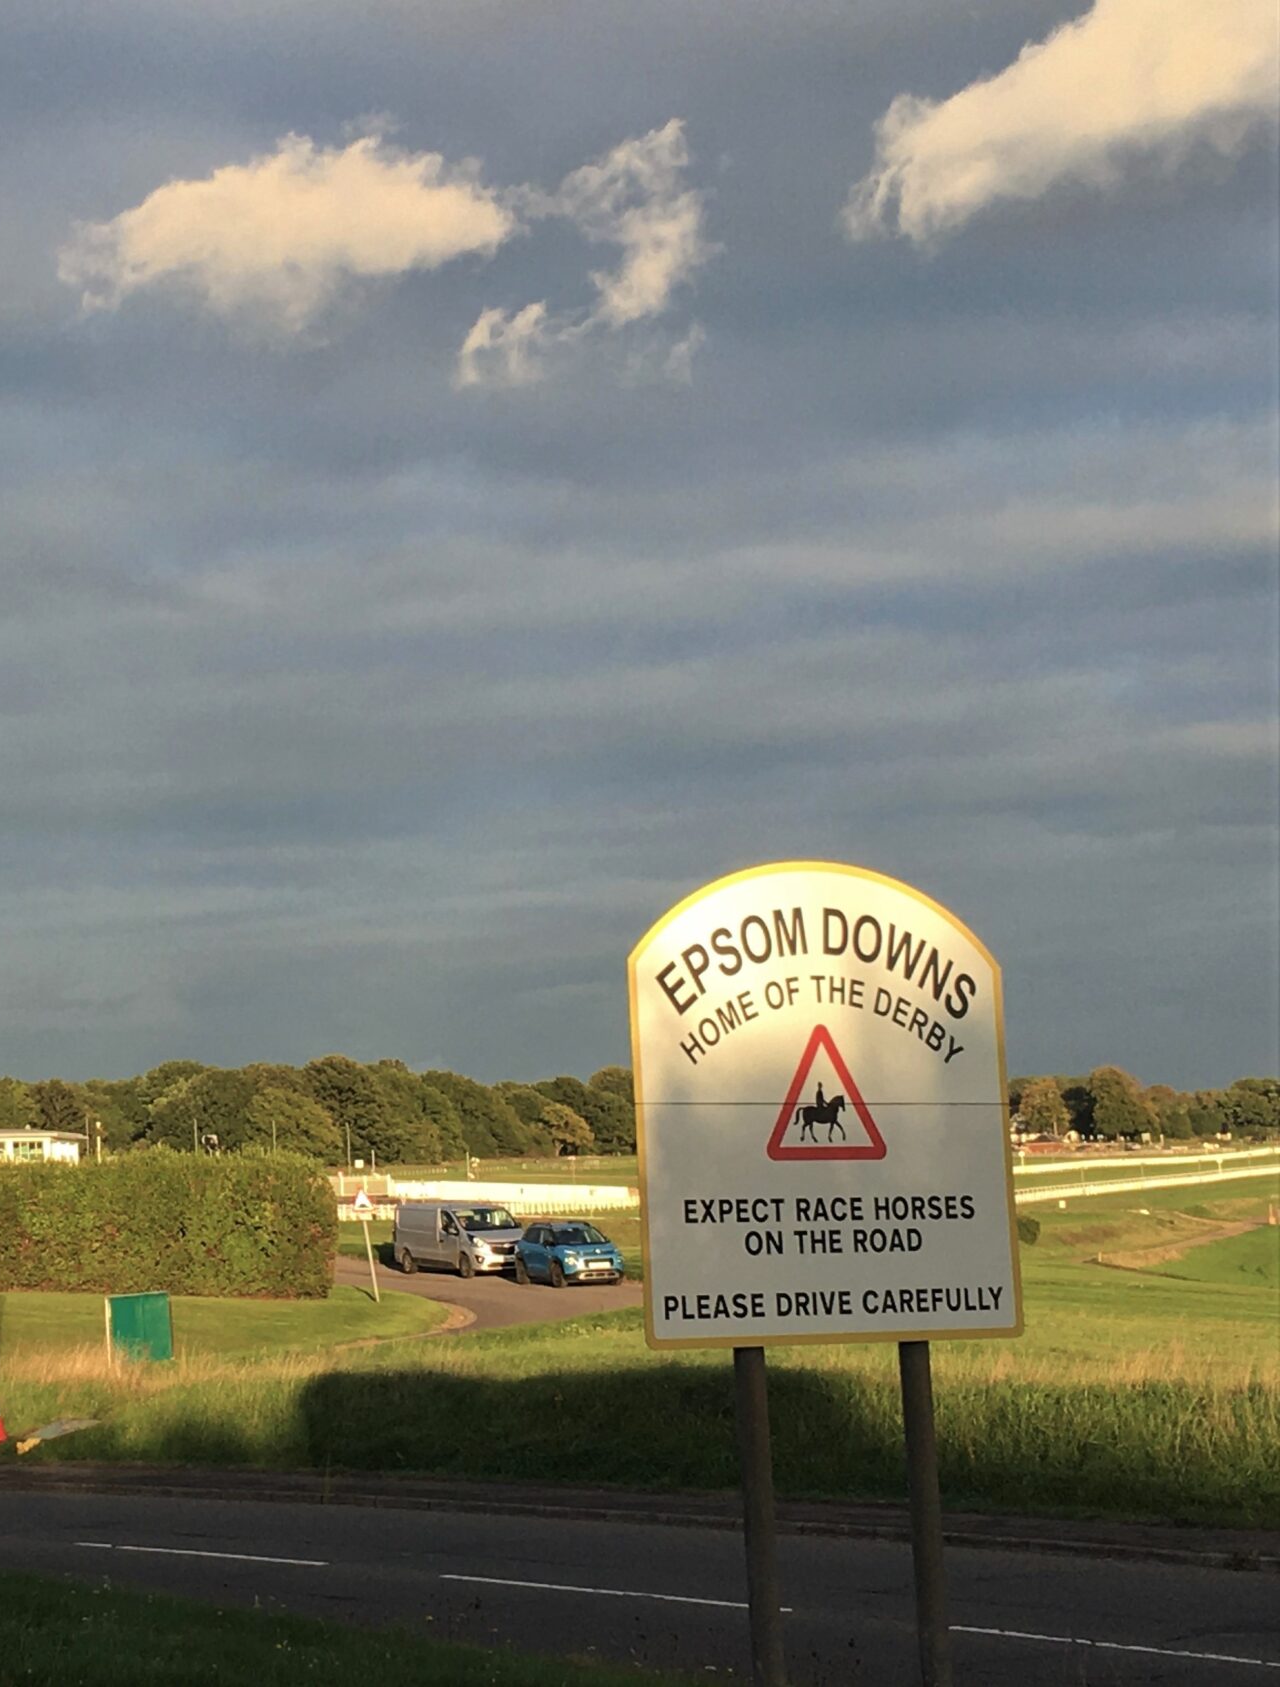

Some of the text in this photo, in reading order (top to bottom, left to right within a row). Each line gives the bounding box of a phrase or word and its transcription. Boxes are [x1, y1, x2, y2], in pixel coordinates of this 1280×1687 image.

[655, 907, 977, 1020] EPSOM DOWNS
[679, 975, 965, 1065] HOME OF THE DERBY
[684, 1195, 976, 1224] EXPECT RACE HORSES
[744, 1228, 923, 1256] ON THE ROAD
[664, 1286, 1004, 1321] PLEASE DRIVE CAREFULLY
